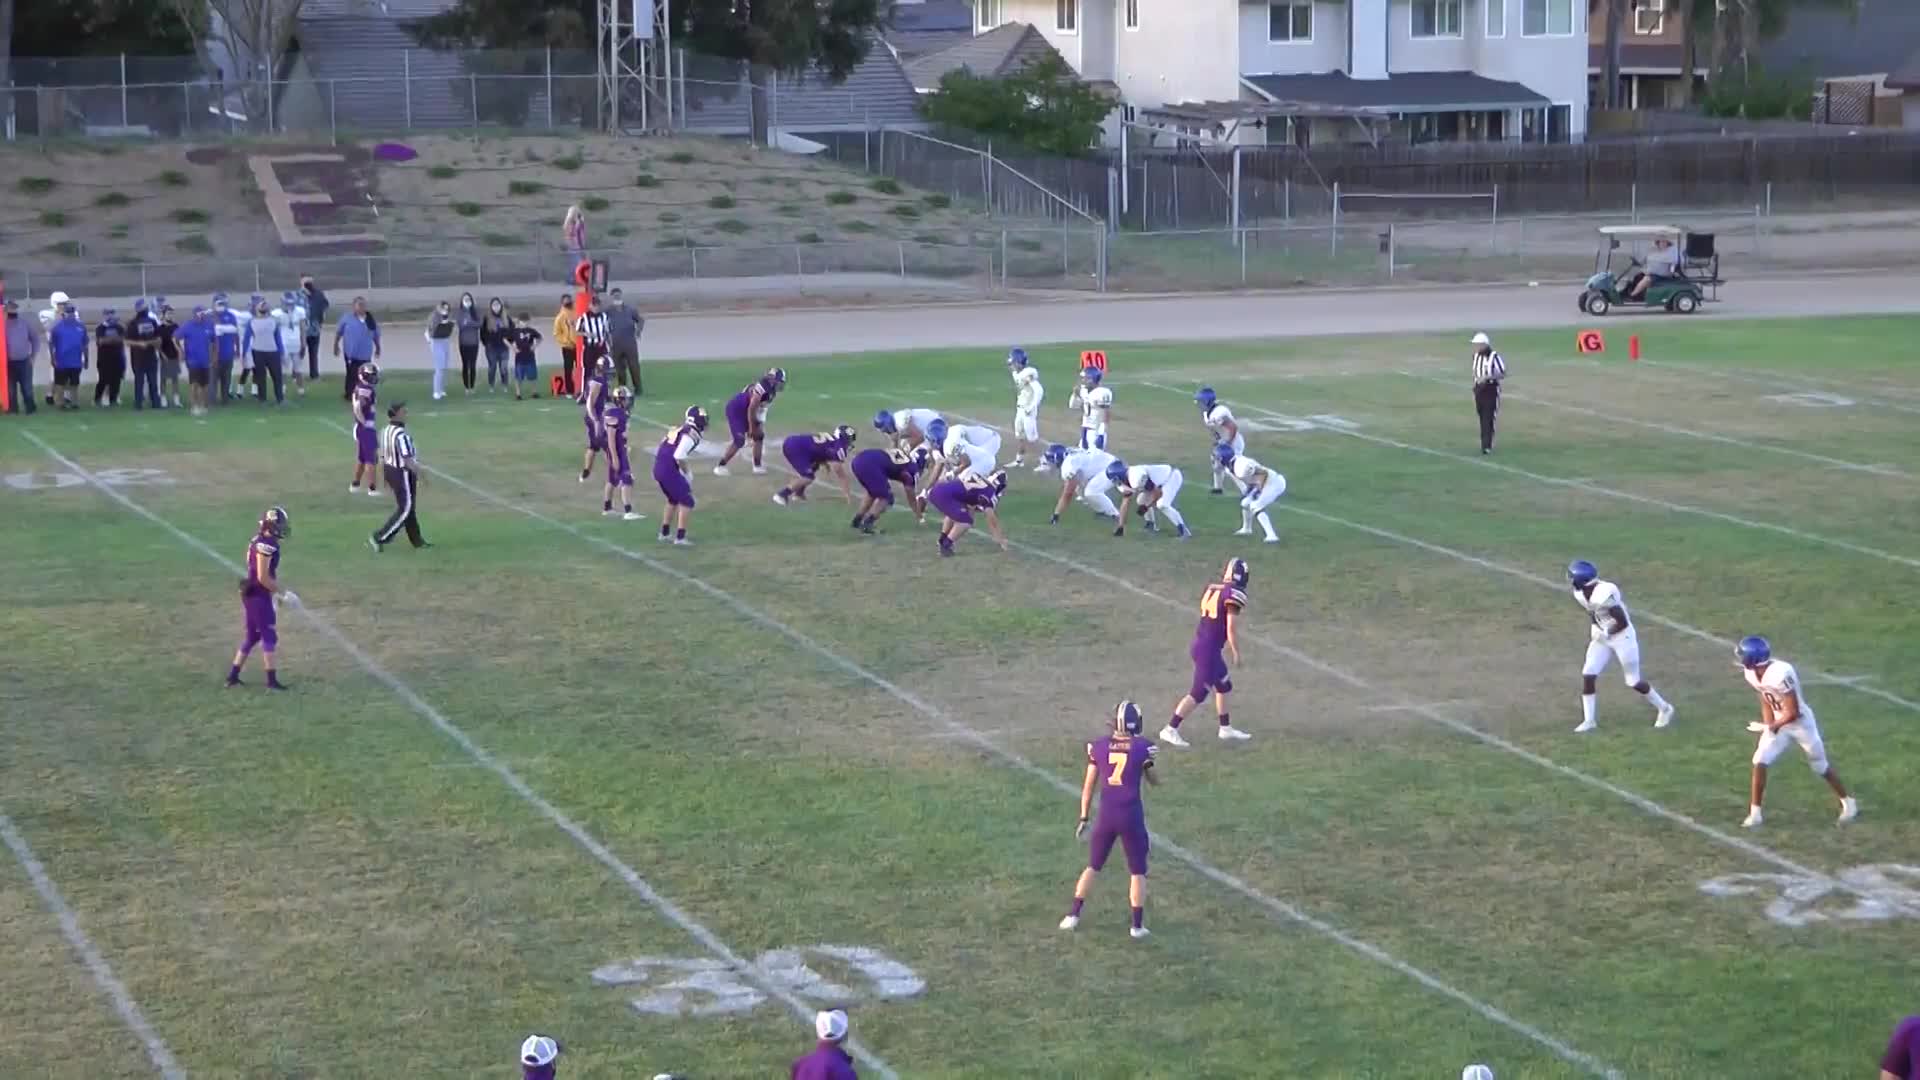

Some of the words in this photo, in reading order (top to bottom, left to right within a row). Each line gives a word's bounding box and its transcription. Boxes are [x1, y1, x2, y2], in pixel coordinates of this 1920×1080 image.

[1584, 334, 1602, 351] G
[1085, 352, 1104, 370] 10
[1108, 752, 1128, 786] 7
[591, 943, 927, 1016] 30
